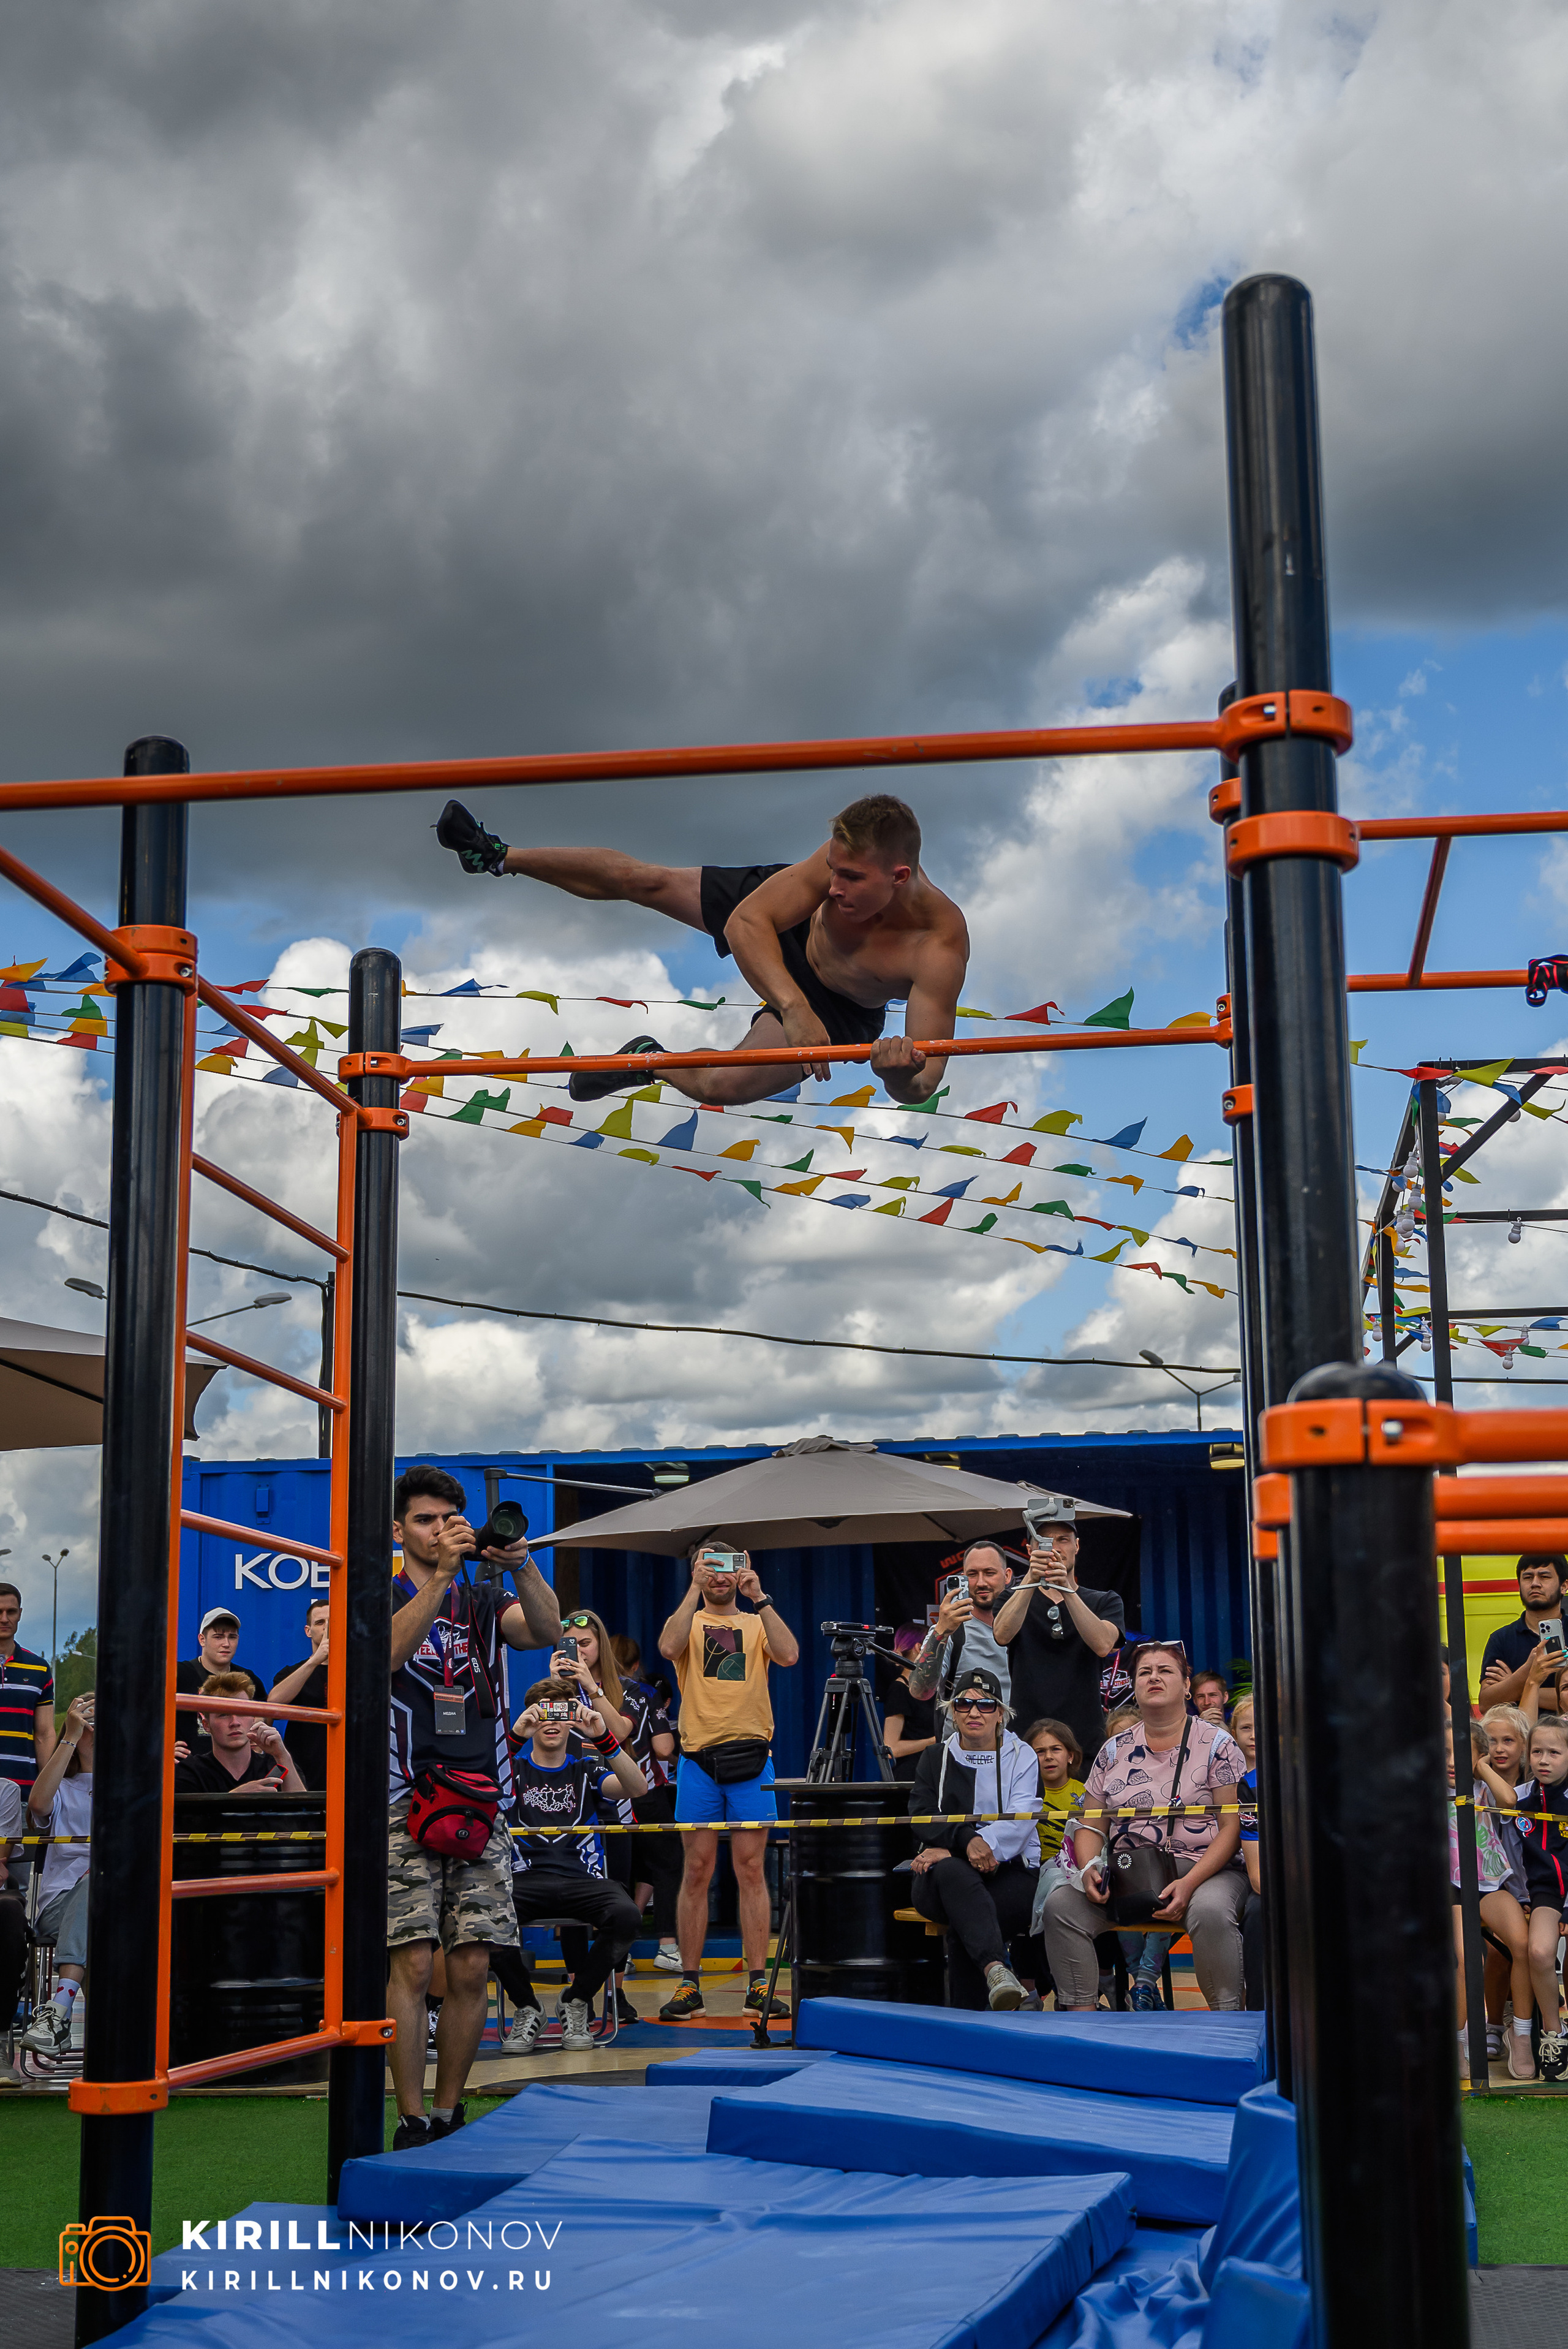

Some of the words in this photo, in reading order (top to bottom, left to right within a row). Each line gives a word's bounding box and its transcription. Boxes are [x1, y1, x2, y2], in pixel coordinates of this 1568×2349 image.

[471, 1657, 481, 1673] EOS
[966, 1754, 976, 1765] ONE
[977, 1755, 993, 1765] LEVEL
